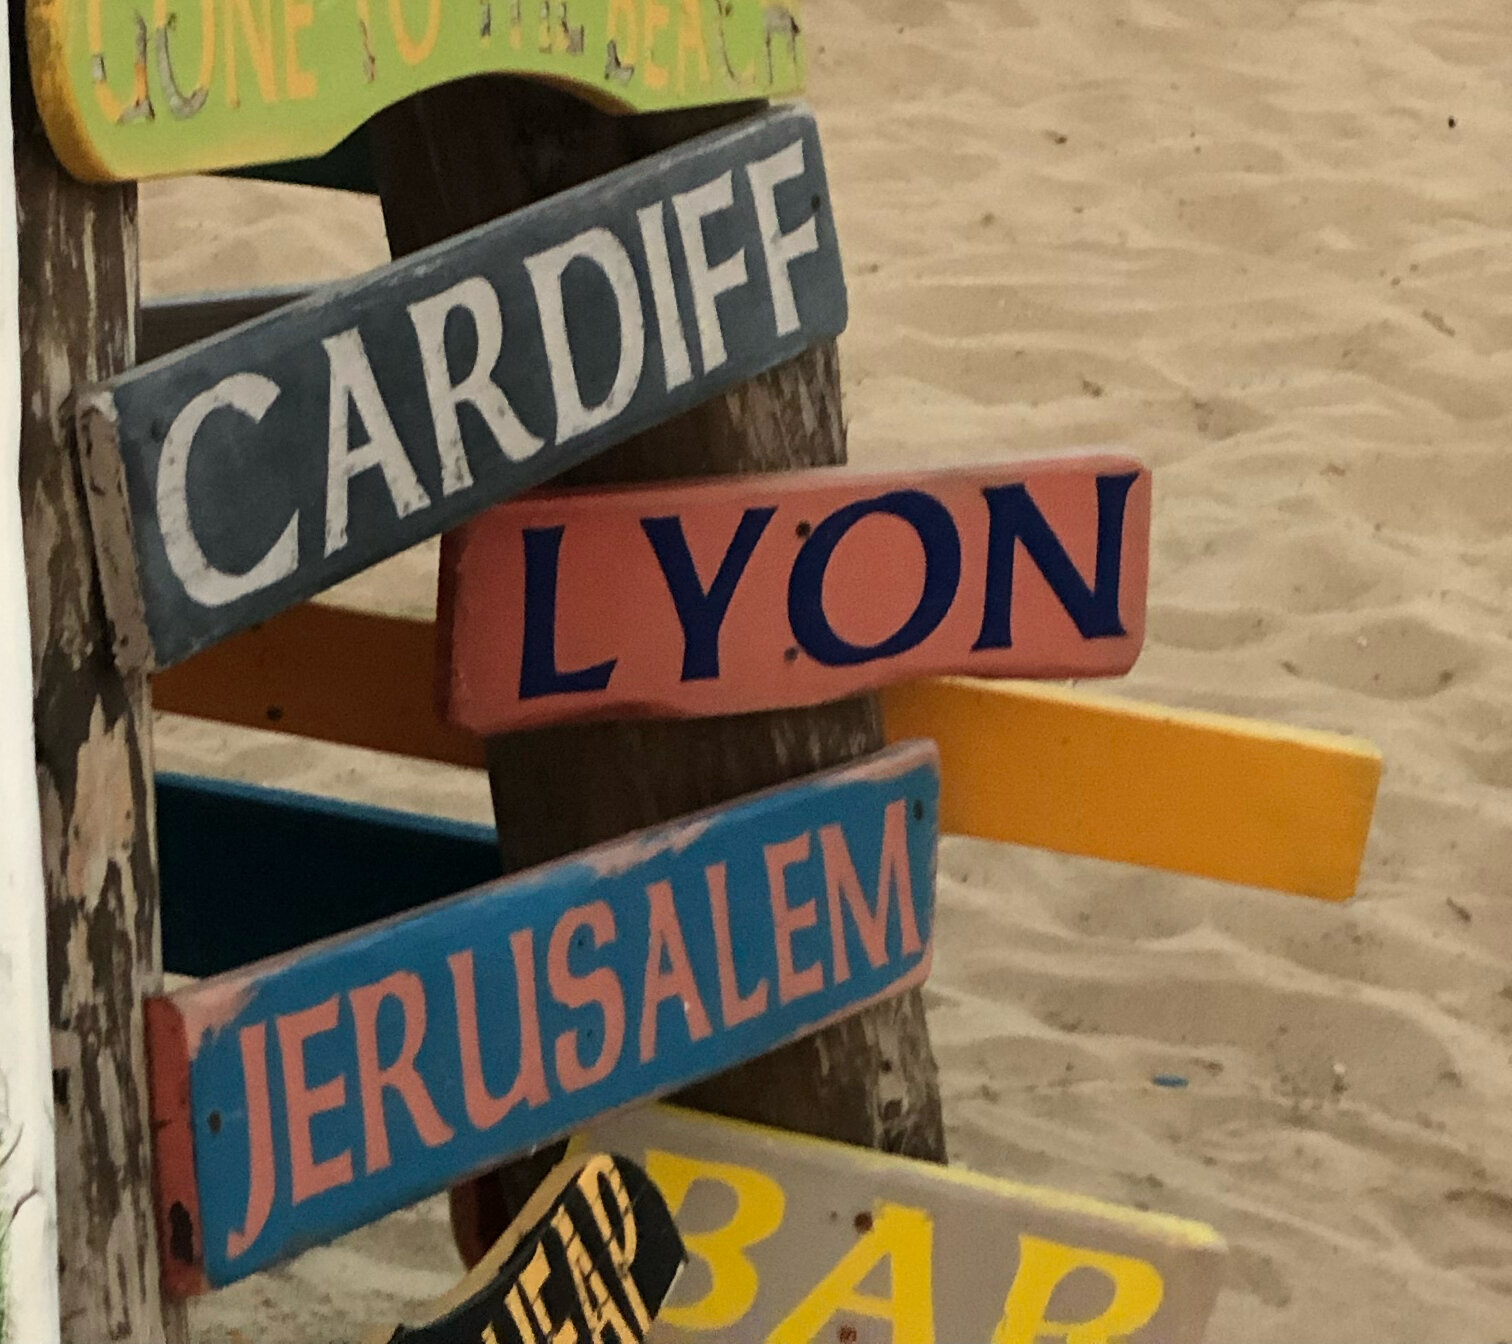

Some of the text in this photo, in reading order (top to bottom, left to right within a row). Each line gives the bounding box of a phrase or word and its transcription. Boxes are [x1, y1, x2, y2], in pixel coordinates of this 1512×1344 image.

[155, 139, 821, 609] CARDIFF
[518, 470, 1141, 701] LYON
[226, 799, 924, 1261] JERUSALEM
[644, 1149, 1165, 1344] BAR
